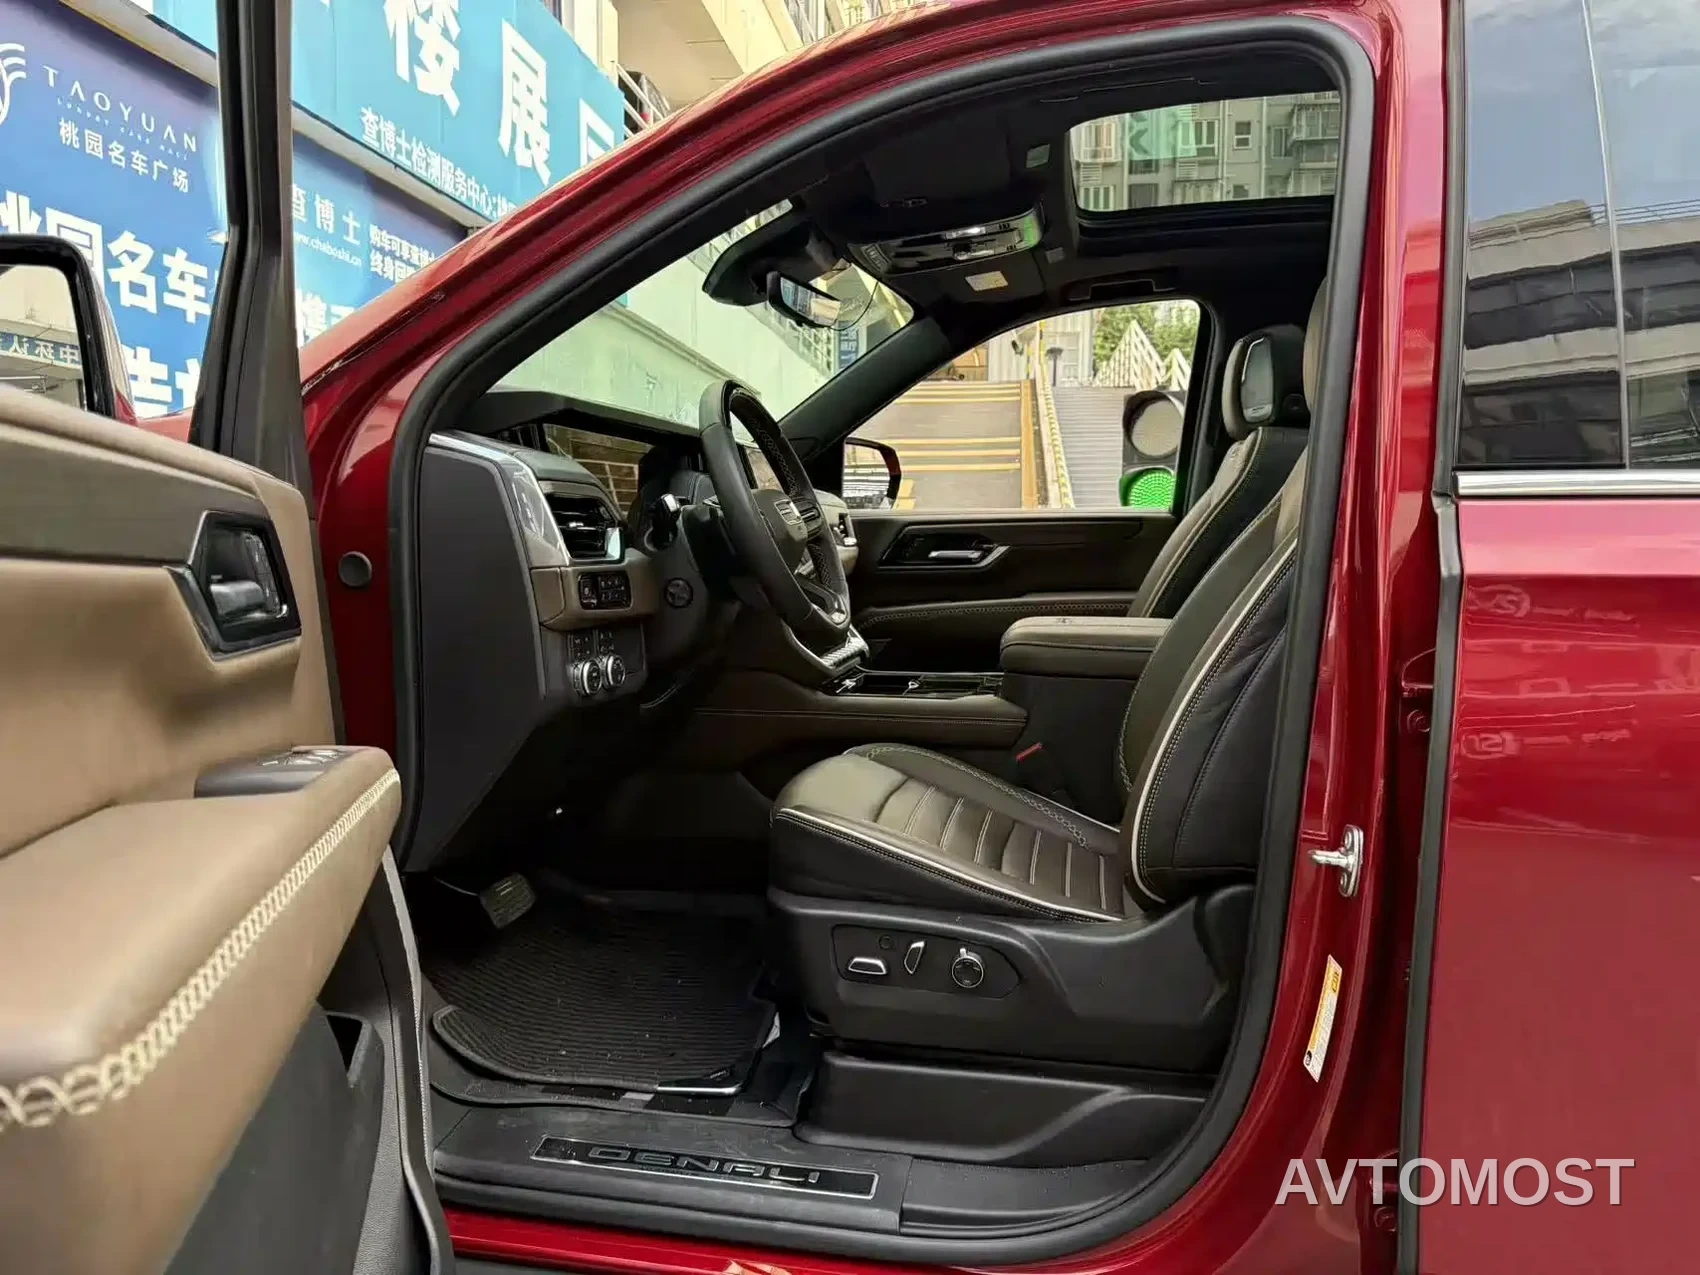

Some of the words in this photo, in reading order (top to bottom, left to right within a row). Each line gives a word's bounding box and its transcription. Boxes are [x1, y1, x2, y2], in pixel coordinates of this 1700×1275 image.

[42, 64, 197, 152] TAOYUAN
[59, 117, 189, 193] 桃园名车广场
[588, 1146, 820, 1183] DENALI
